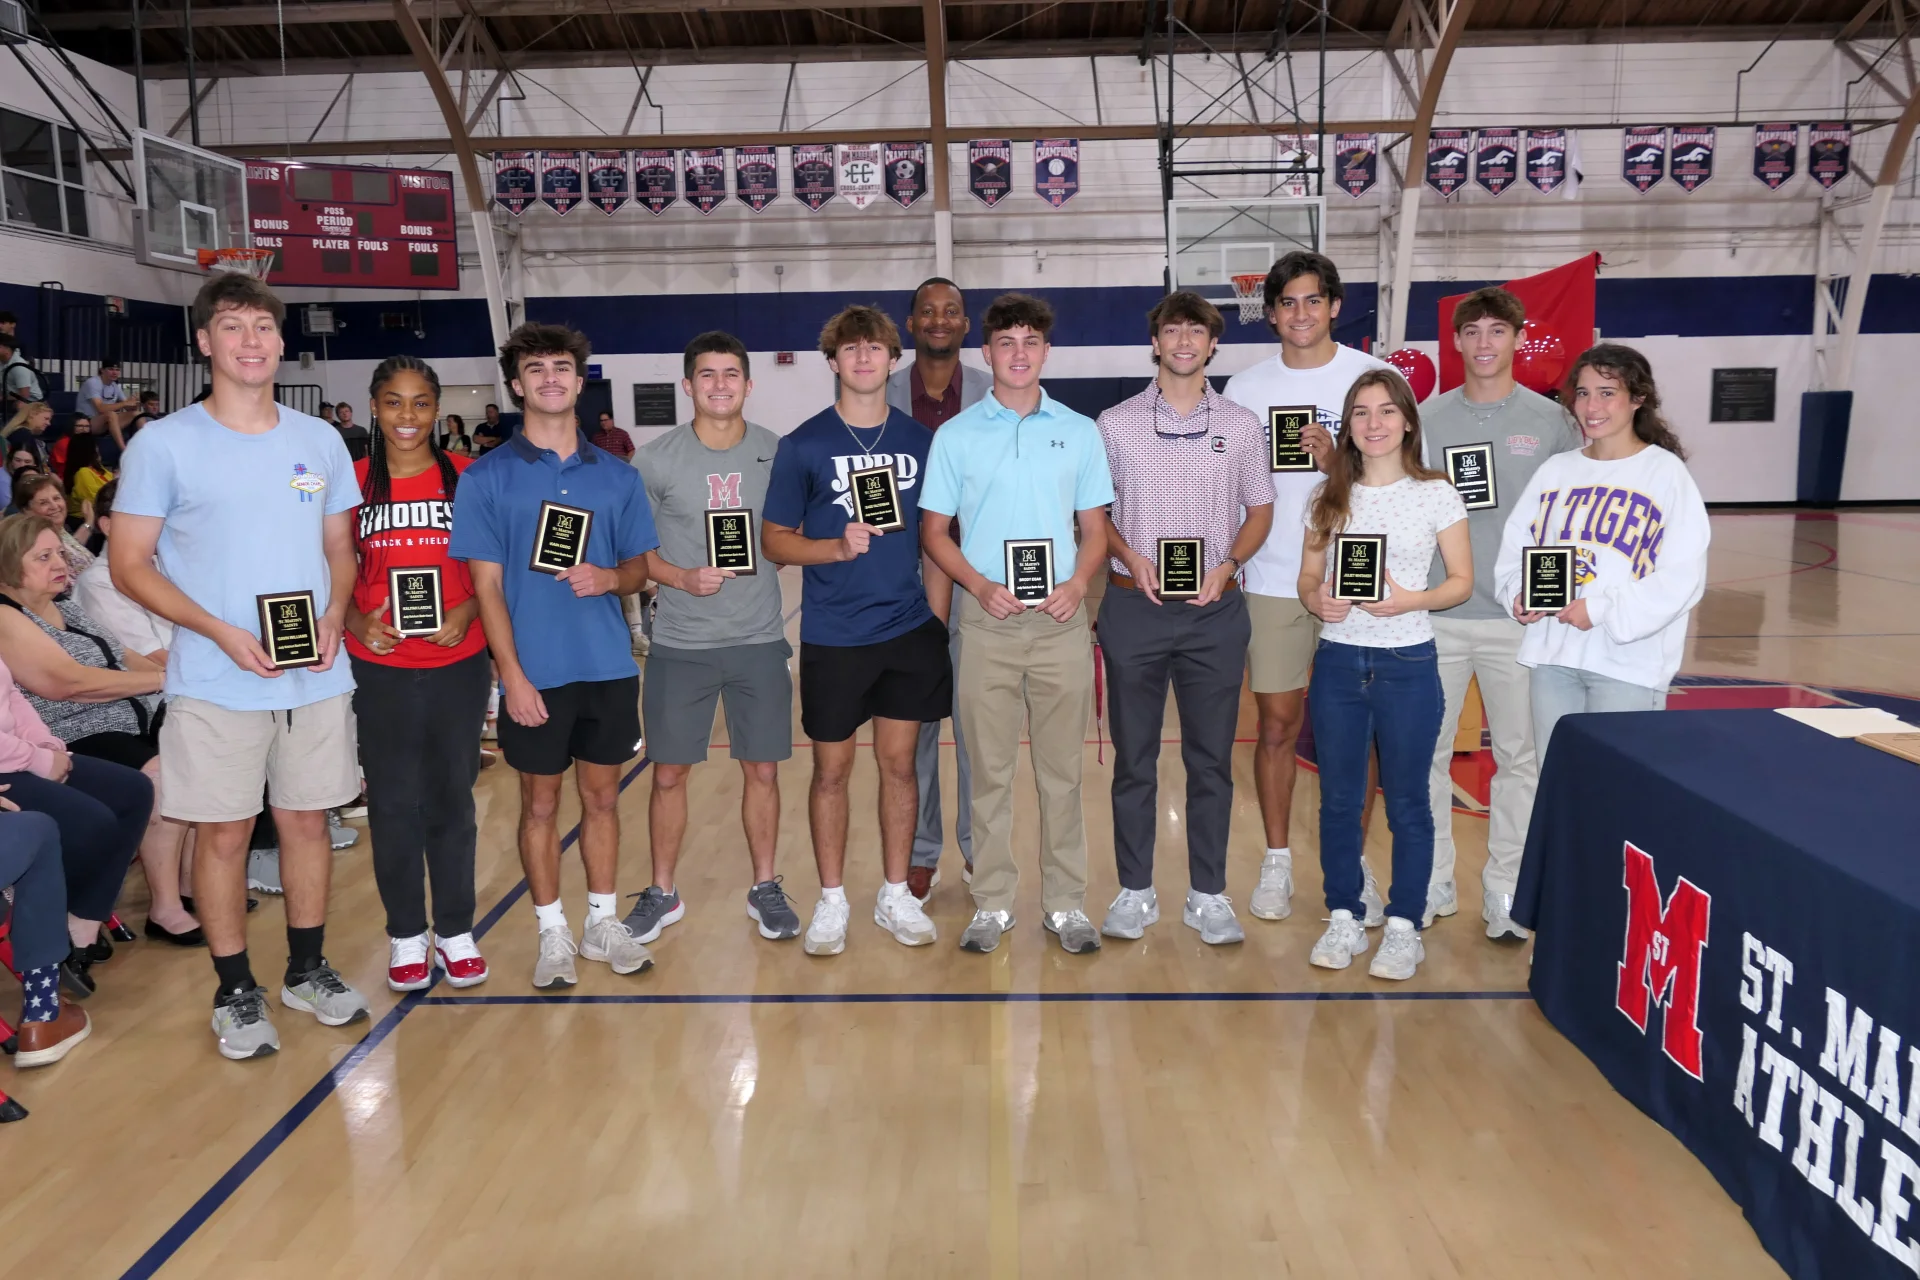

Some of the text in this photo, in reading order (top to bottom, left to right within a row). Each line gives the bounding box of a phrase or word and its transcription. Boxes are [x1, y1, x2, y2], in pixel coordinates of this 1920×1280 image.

[1036, 147, 1078, 163] CHAMPIONS
[1337, 140, 1375, 155] CHAMPIONS
[737, 154, 775, 170] CHAMPIONS
[794, 152, 833, 168] CHAMPIONS
[885, 150, 924, 165] CHAMPIONS
[971, 148, 1009, 163] CHAMPIONS
[496, 158, 534, 174] CHAMPIONS
[542, 158, 580, 173] CHAMPIONS
[588, 158, 626, 173] CHAMPIONS
[636, 157, 674, 172] CHAMPIONS
[685, 156, 723, 171] CHAMPIONS
[400, 175, 451, 189] VISITOR
[324, 207, 344, 215] POSS
[254, 219, 289, 230] BONUS
[316, 216, 353, 226] PERIOD
[400, 225, 433, 236] BONUS
[313, 239, 389, 251] PLAYER FOULS
[409, 243, 438, 253] FOULS
[707, 472, 741, 509] M
[369, 537, 449, 548] TRACK & FIELD
[1652, 930, 1670, 966] ST
[1616, 840, 1711, 1083] M
[1740, 931, 1802, 1048] ST.
